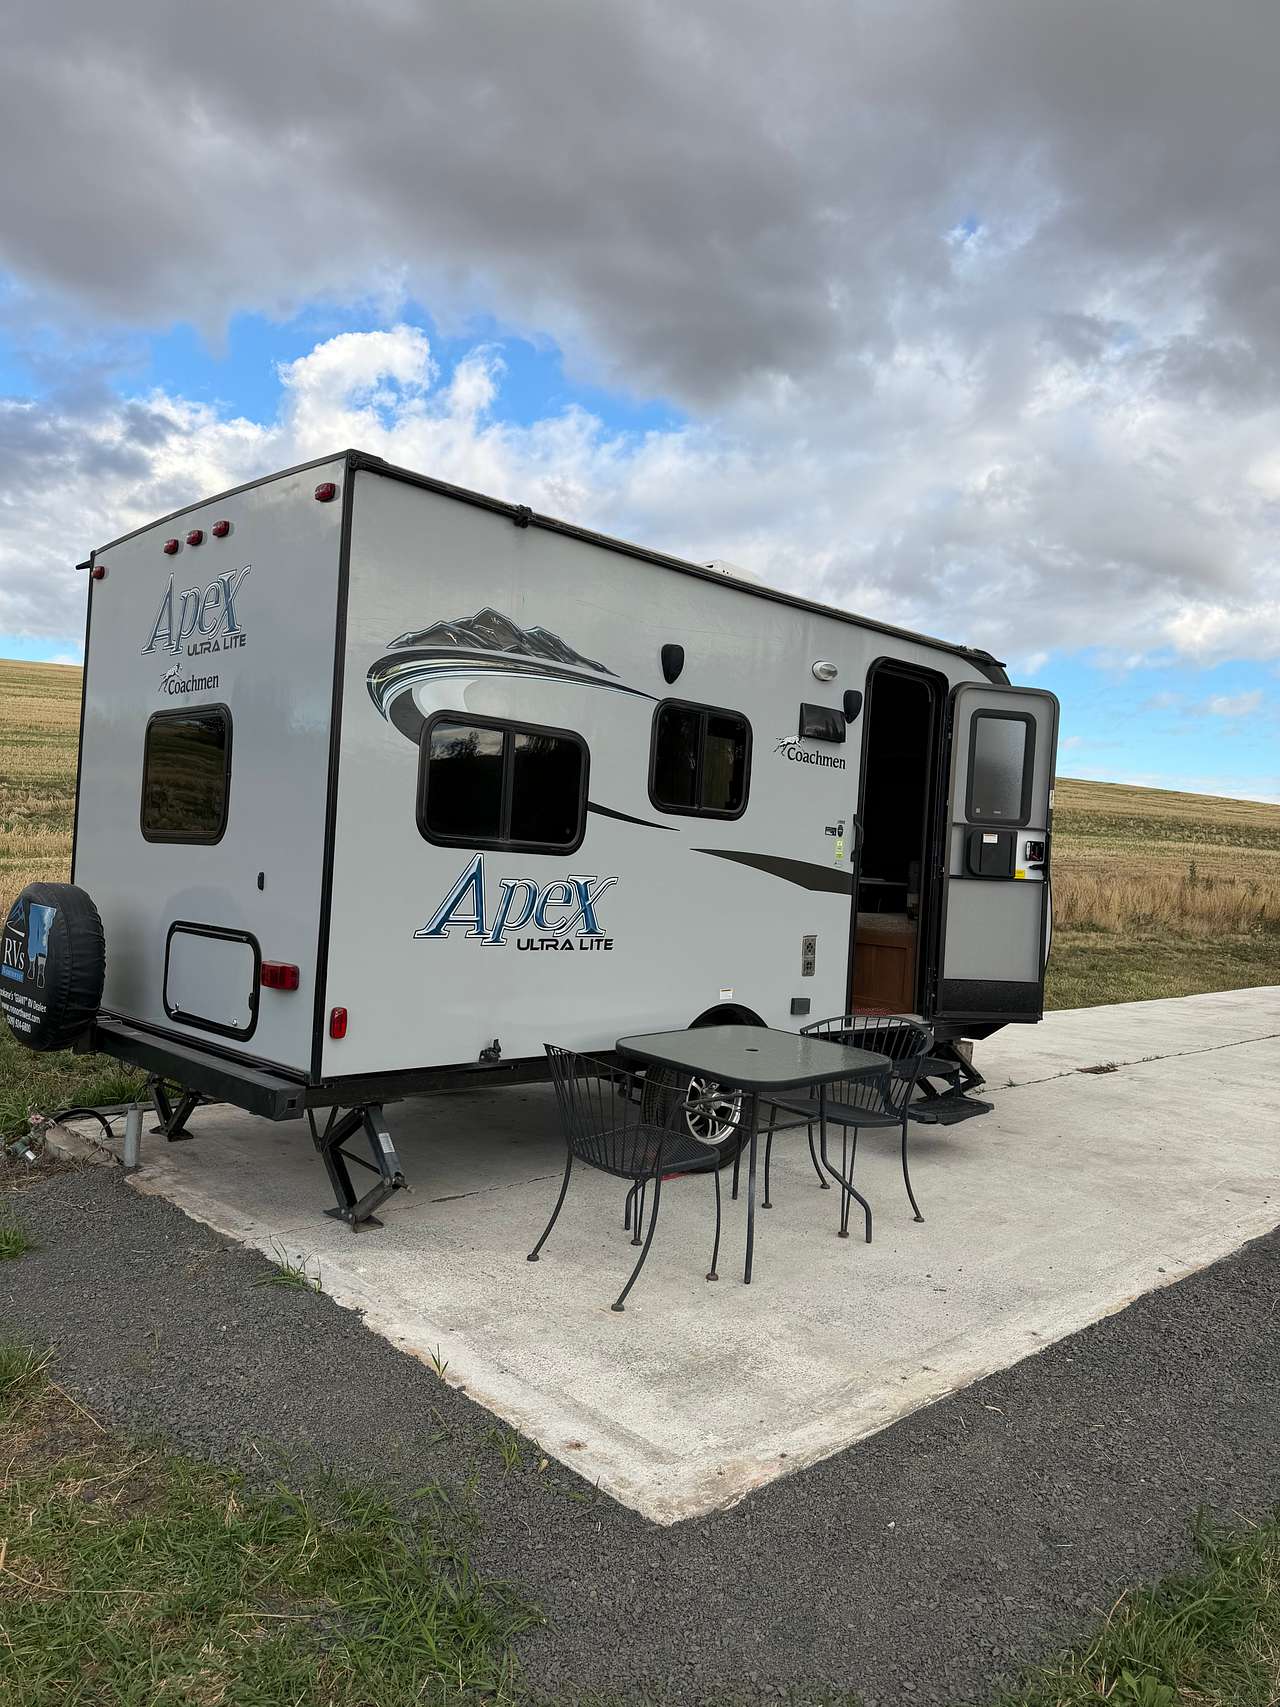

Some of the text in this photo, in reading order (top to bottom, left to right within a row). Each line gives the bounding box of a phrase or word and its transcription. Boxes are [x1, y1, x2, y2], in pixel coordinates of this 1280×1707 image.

[141, 565, 251, 656] Apex
[187, 634, 247, 656] ULTRA LITE
[168, 675, 219, 695] Coachmen
[787, 747, 846, 769] Coachmen
[413, 853, 618, 946] Apex
[4, 937, 25, 970] RVs
[517, 939, 614, 951] ULTRA LITE
